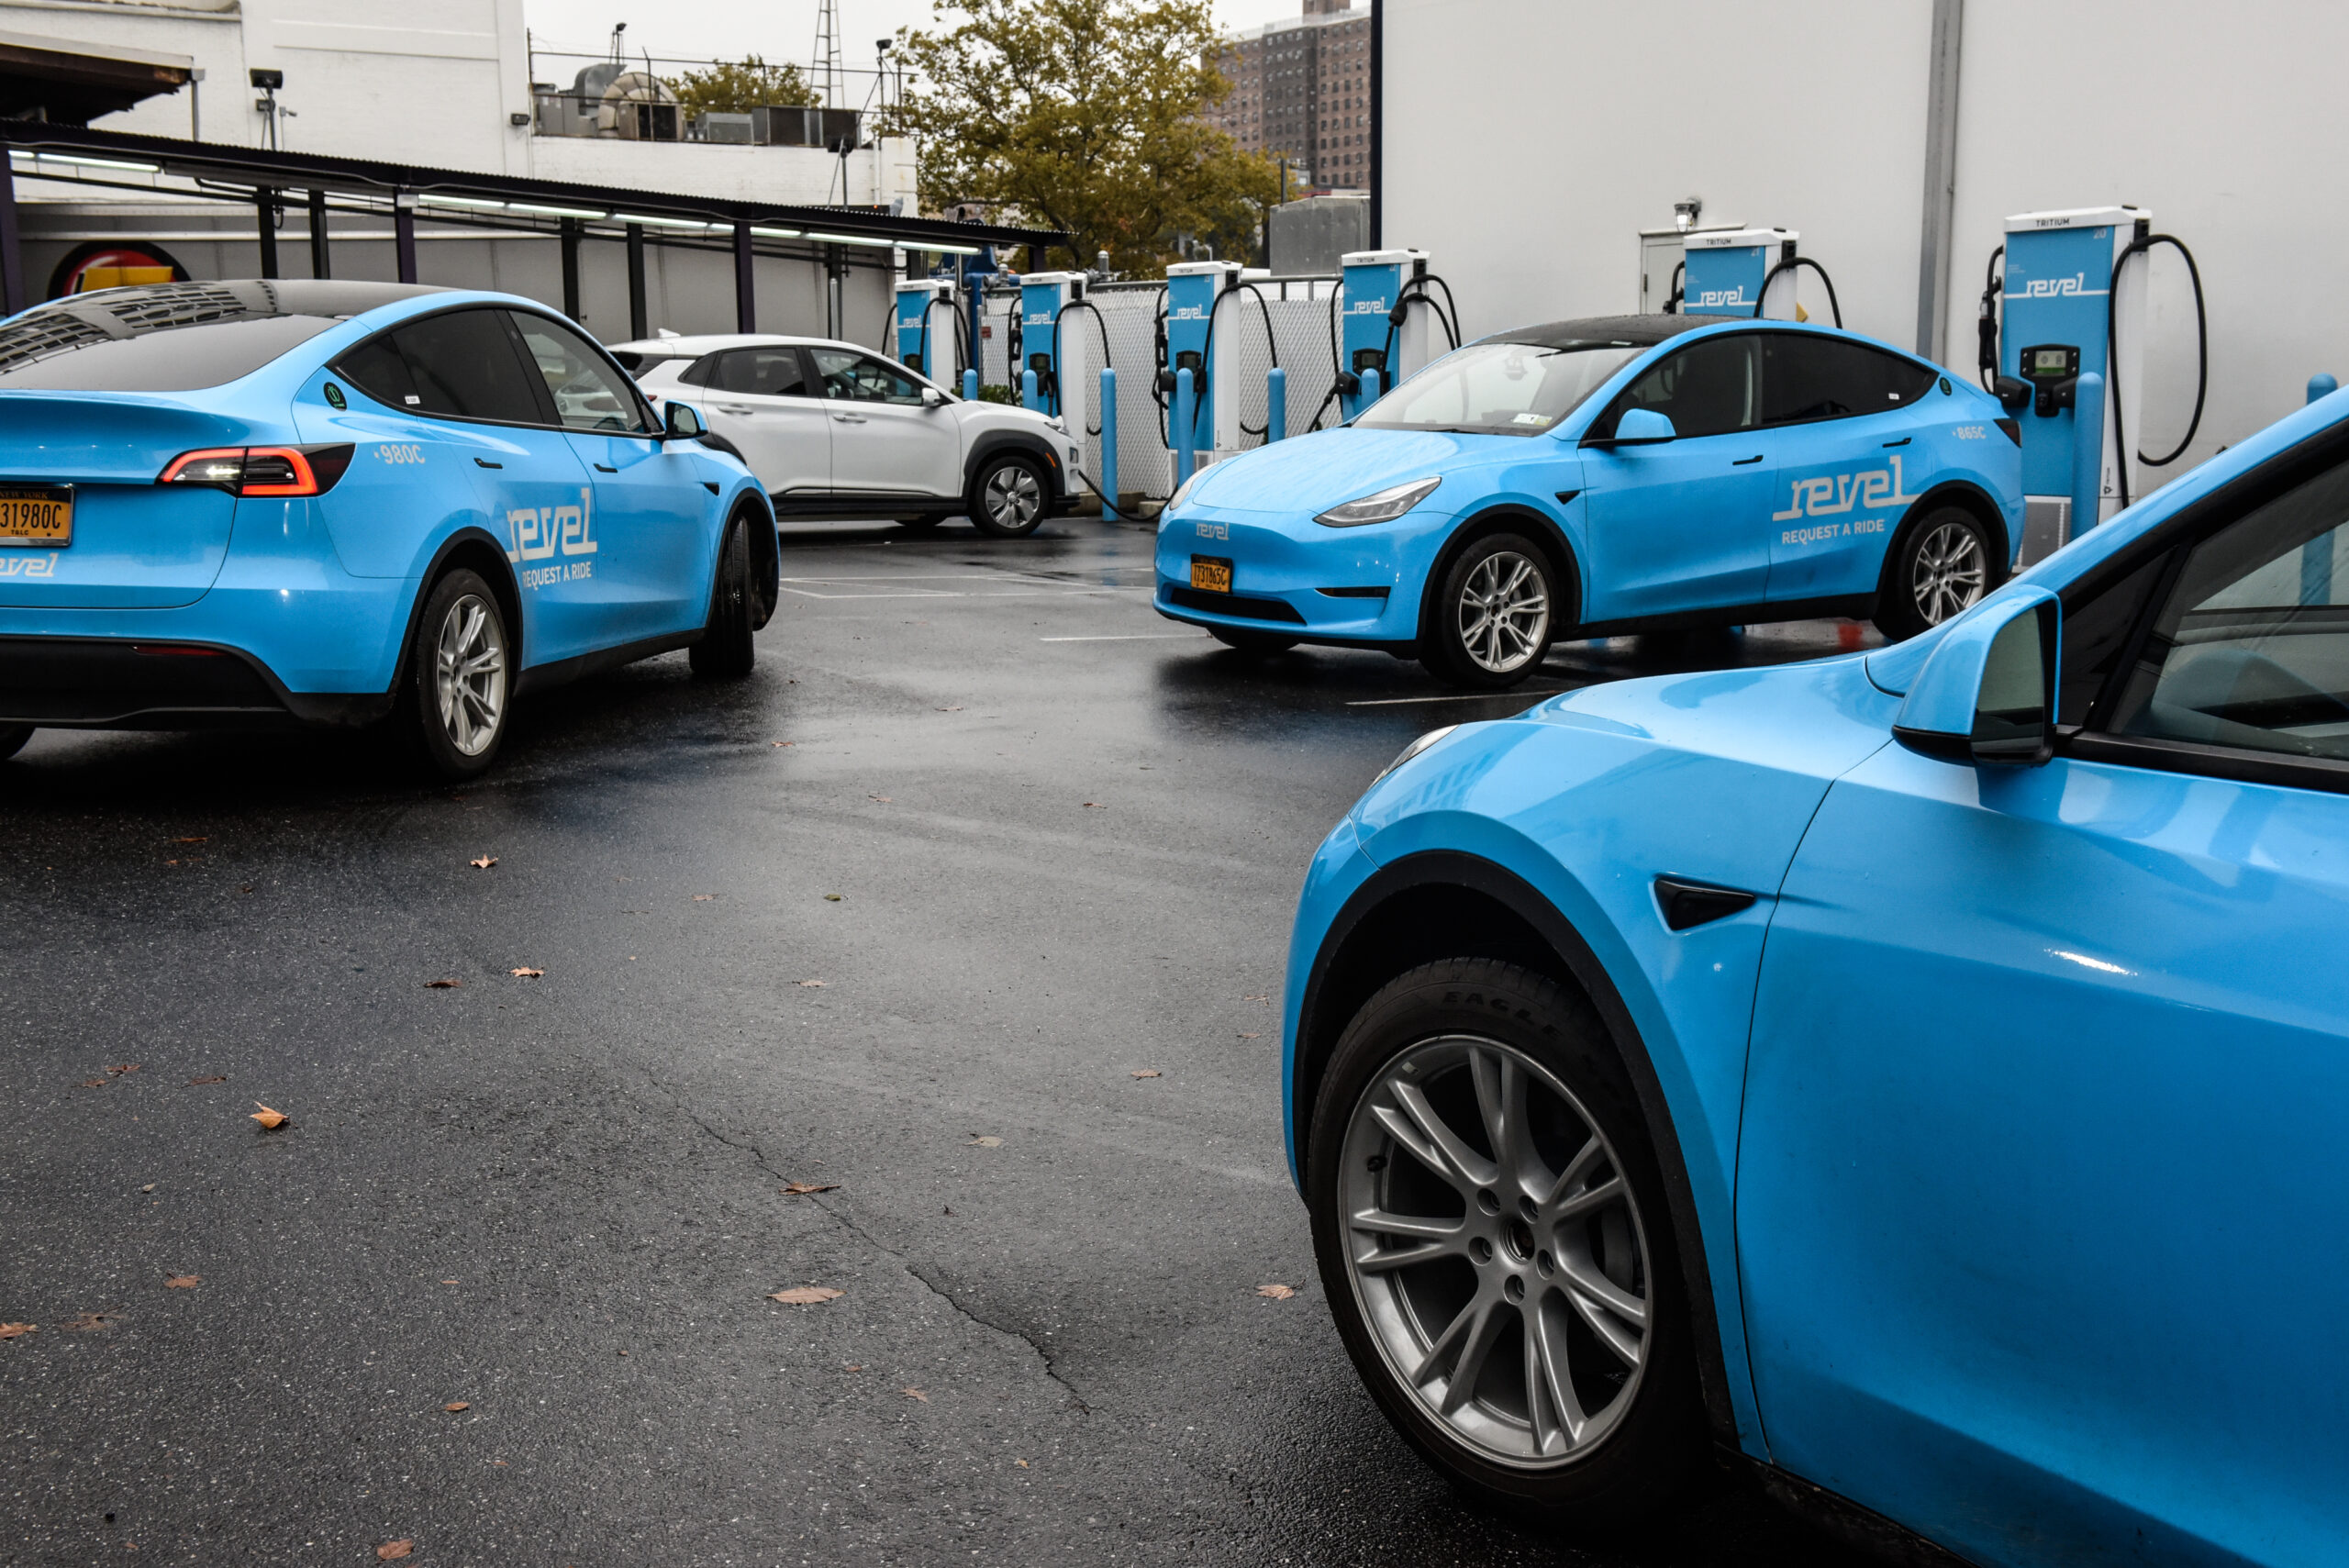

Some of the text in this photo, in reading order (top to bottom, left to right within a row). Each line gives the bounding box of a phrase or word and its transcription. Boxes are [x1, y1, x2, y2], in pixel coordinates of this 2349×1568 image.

[2035, 218, 2070, 228] TRITIUM
[2093, 228, 2108, 239] 20
[1697, 285, 1747, 307] revel
[2021, 272, 2088, 299] revel
[1175, 304, 1205, 320] revel
[1353, 296, 1388, 315] revel
[1772, 454, 1922, 522] revel
[507, 487, 597, 563] revel
[1196, 522, 1230, 541] revel
[1782, 518, 1886, 546] REQUEST A RIDE
[0, 552, 59, 578] vel
[522, 561, 592, 591] REQUEST A RIDE
[1442, 991, 1562, 1040] EAGLE
